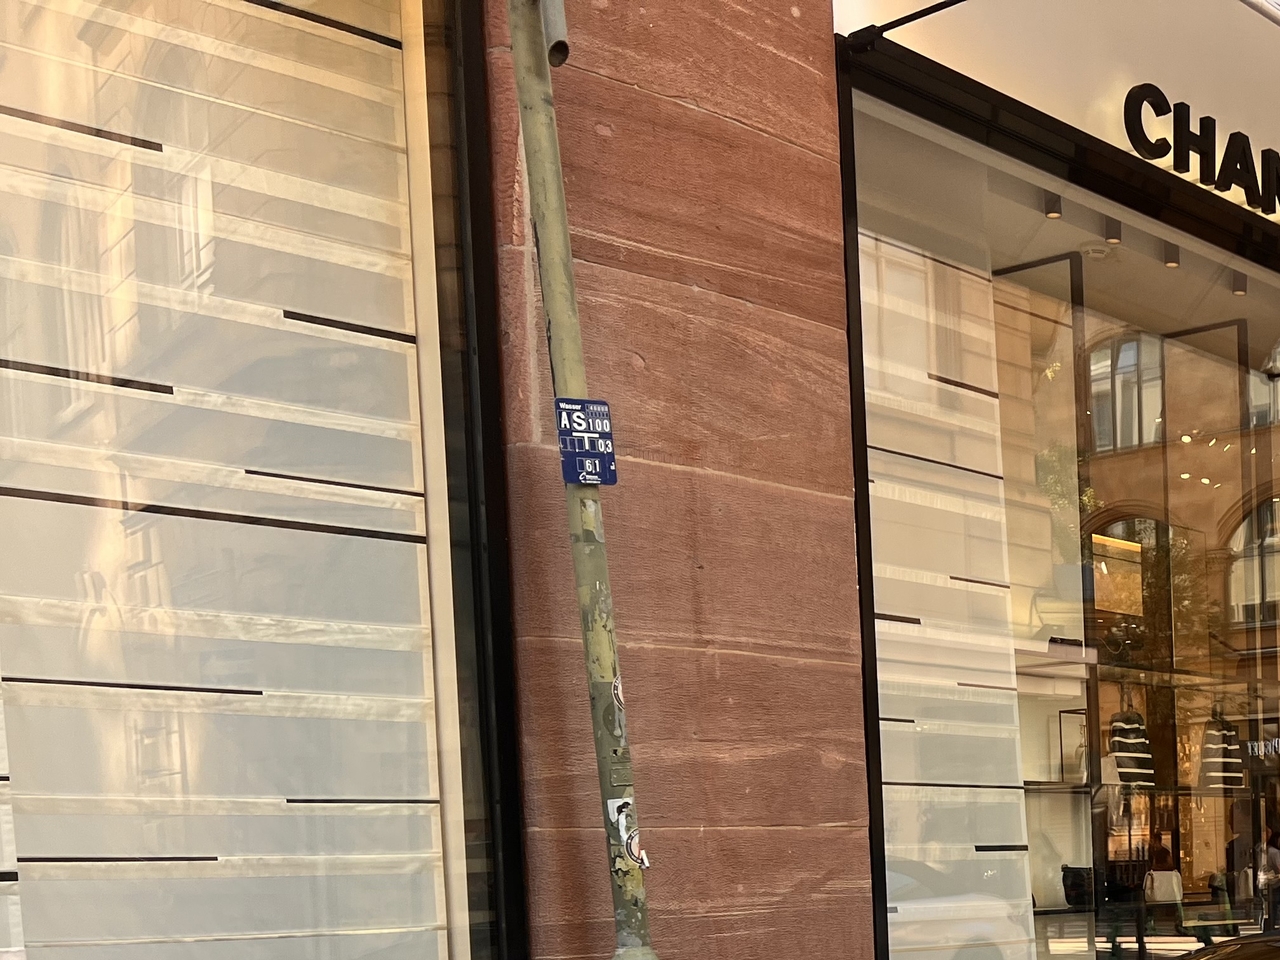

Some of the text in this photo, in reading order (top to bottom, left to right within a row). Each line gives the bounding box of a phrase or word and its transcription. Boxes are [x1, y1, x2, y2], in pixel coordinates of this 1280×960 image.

[559, 402, 581, 410] Wasser
[588, 418, 610, 432] 100
[572, 431, 600, 450] T
